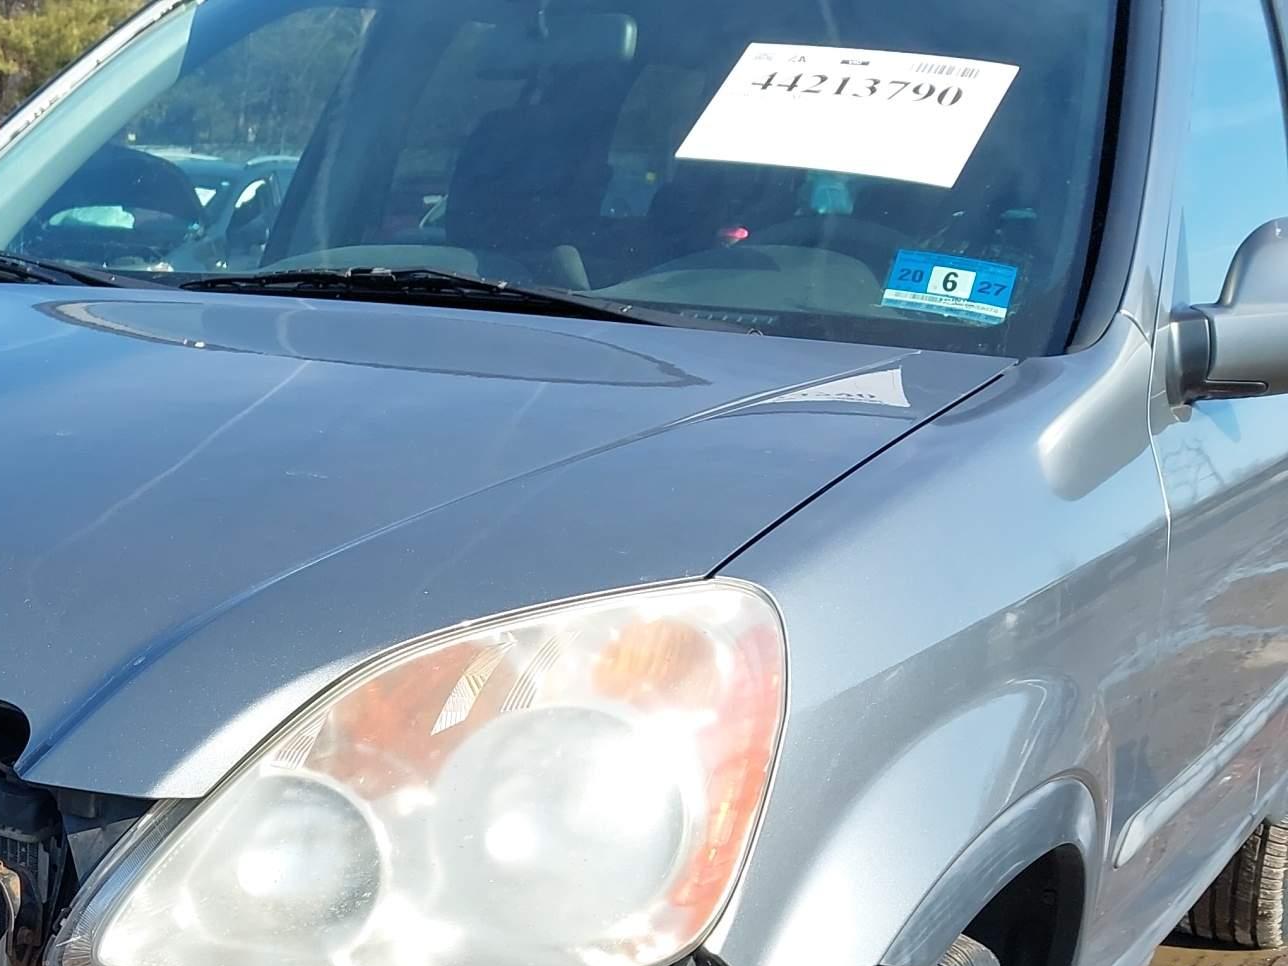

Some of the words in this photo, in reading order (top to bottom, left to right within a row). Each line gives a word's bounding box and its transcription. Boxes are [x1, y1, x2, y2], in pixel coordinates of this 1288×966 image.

[751, 71, 963, 106] 44213790
[898, 268, 924, 283] 20
[942, 271, 959, 292] 6
[977, 281, 1007, 296] 27
